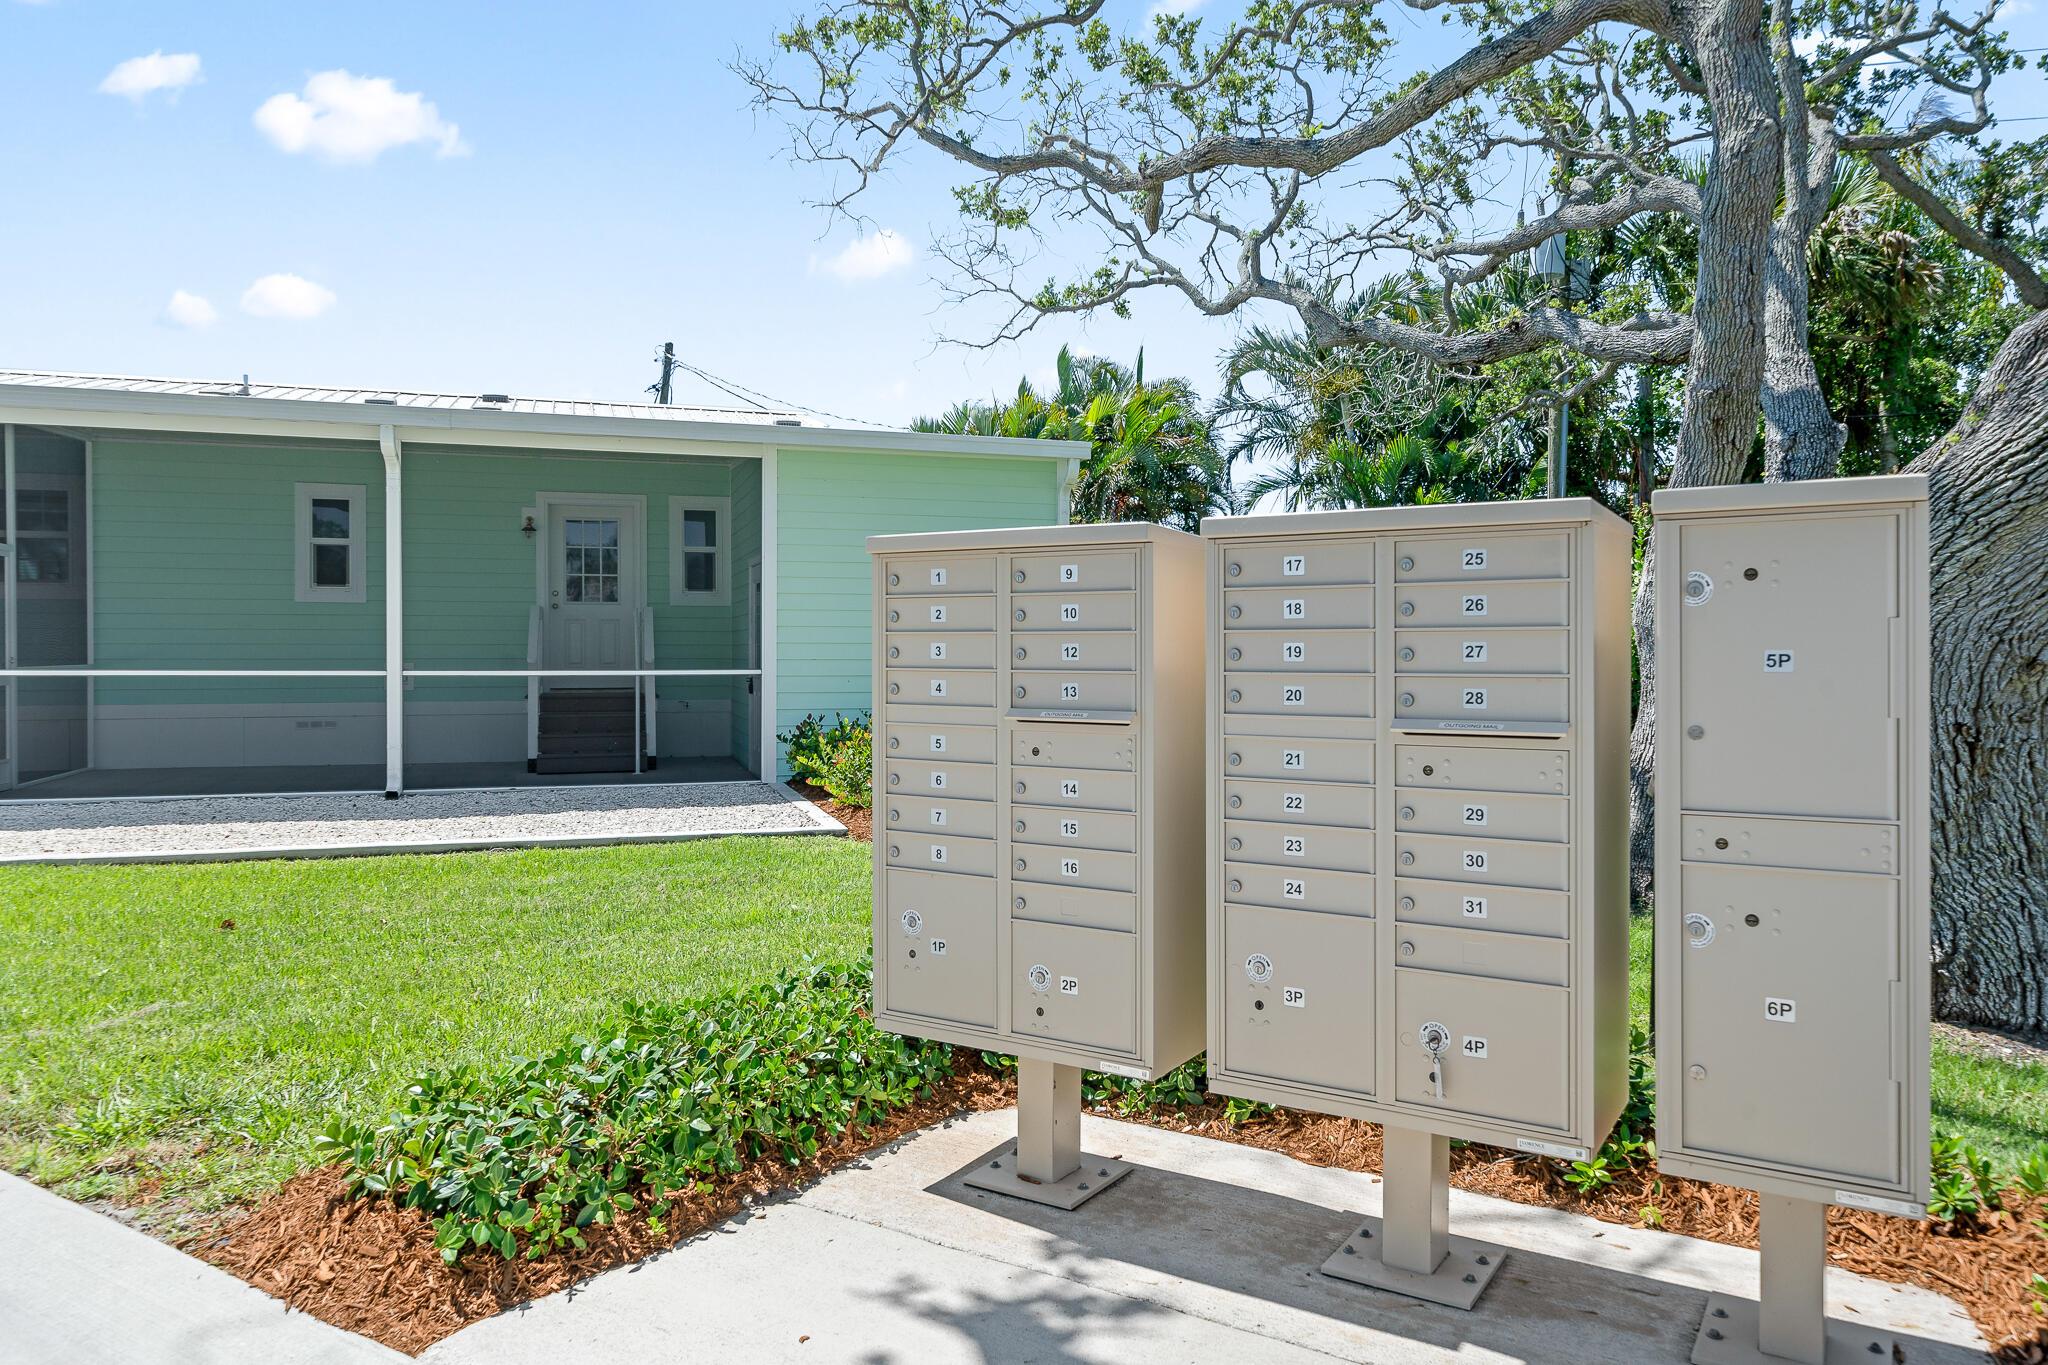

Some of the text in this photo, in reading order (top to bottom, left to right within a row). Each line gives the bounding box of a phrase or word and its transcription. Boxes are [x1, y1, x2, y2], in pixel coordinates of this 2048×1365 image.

[1286, 559, 1302, 572] 17
[1464, 552, 1484, 566] 25
[935, 571, 941, 583] 1
[1065, 568, 1073, 580] 9
[1286, 602, 1302, 616] 18
[1465, 598, 1484, 612] 26
[935, 609, 942, 620] 2
[1063, 607, 1077, 619] 10
[935, 645, 942, 657] 3
[1063, 646, 1078, 658] 12
[1285, 645, 1302, 658] 19
[1464, 645, 1484, 658] 27
[1766, 653, 1792, 668] 5P
[935, 682, 943, 694] 4
[1063, 686, 1077, 698] 13
[1285, 689, 1302, 702] 20
[1464, 691, 1484, 705] 28
[935, 738, 942, 749] 5
[1285, 752, 1301, 766] 21
[935, 775, 942, 786] 6
[1063, 783, 1078, 795] 14
[1285, 796, 1303, 810] 22
[935, 811, 942, 823] 7
[1465, 807, 1484, 822] 29
[1063, 822, 1077, 835] 15
[1285, 839, 1303, 853] 23
[935, 848, 943, 860] 8
[1063, 861, 1078, 874] 16
[1465, 854, 1485, 868] 30
[1285, 882, 1303, 896] 24
[1465, 900, 1483, 914] 31
[932, 940, 946, 953] 1P
[1061, 979, 1077, 992] 2P
[1285, 989, 1303, 1003] 3P
[1767, 1001, 1793, 1017] 6P
[1464, 1039, 1485, 1054] 4P
